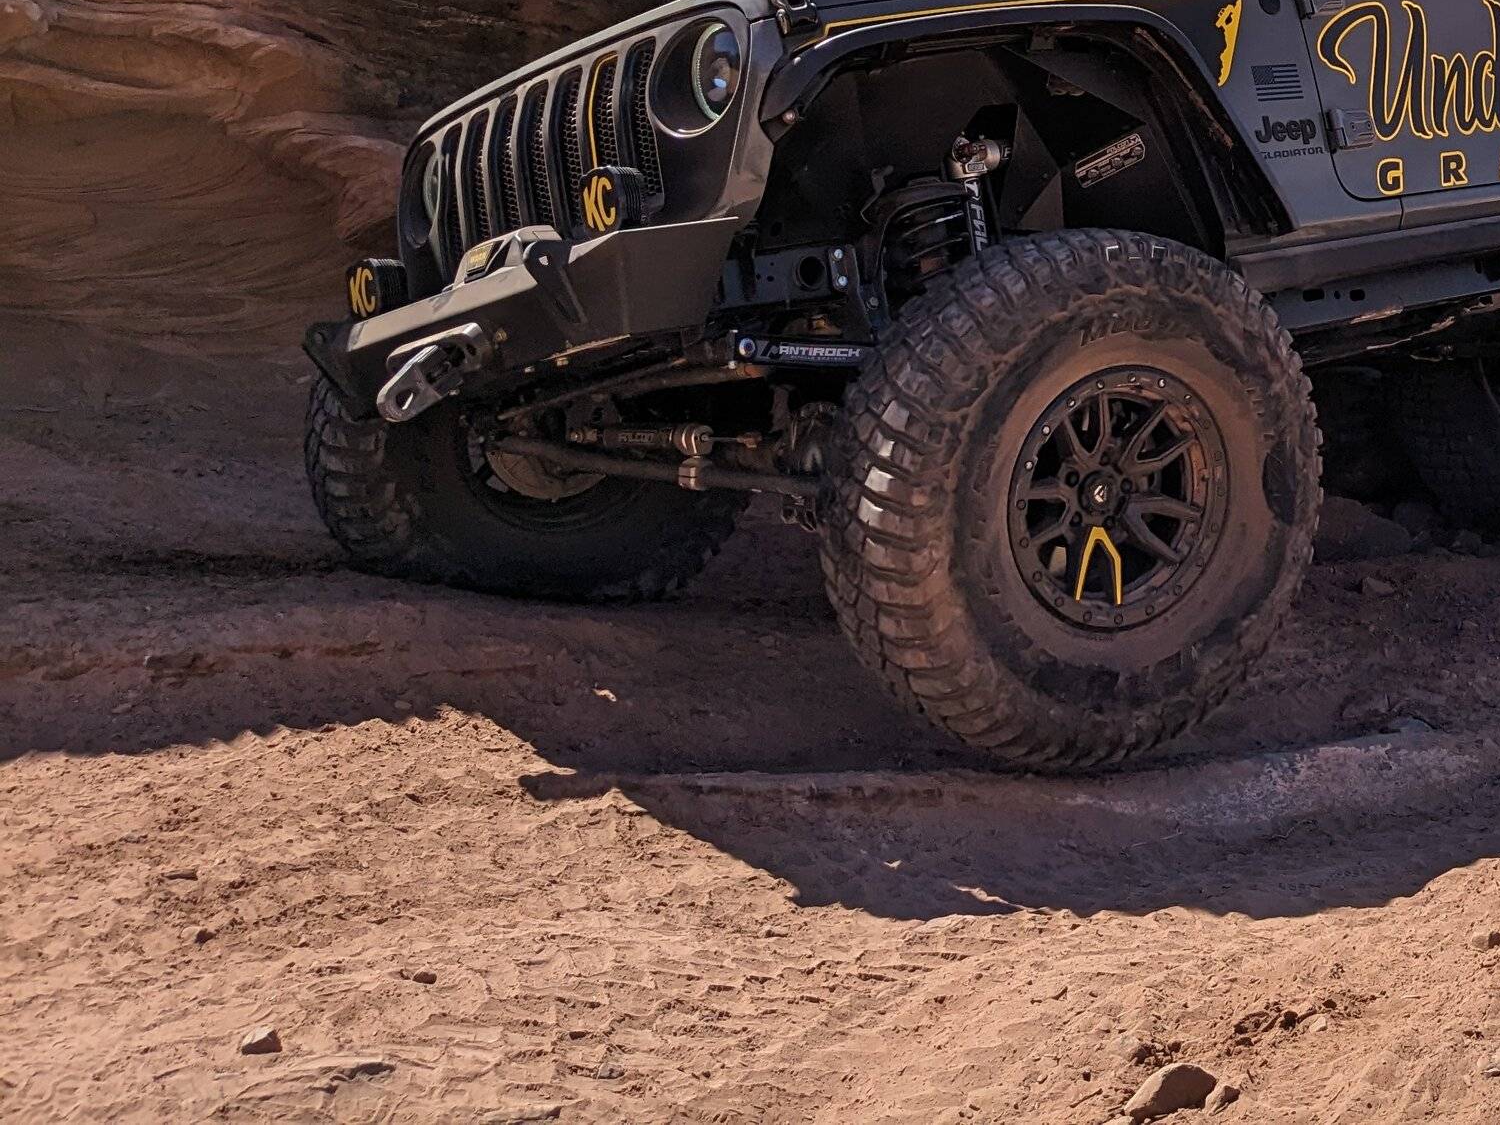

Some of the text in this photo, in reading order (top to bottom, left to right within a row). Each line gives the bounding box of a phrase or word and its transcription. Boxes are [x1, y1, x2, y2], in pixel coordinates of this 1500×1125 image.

[1254, 115, 1318, 145] Jeep
[582, 175, 617, 232] KC
[970, 203, 988, 251] FAL
[349, 266, 377, 318] KC
[778, 345, 861, 357] ANTIROCK
